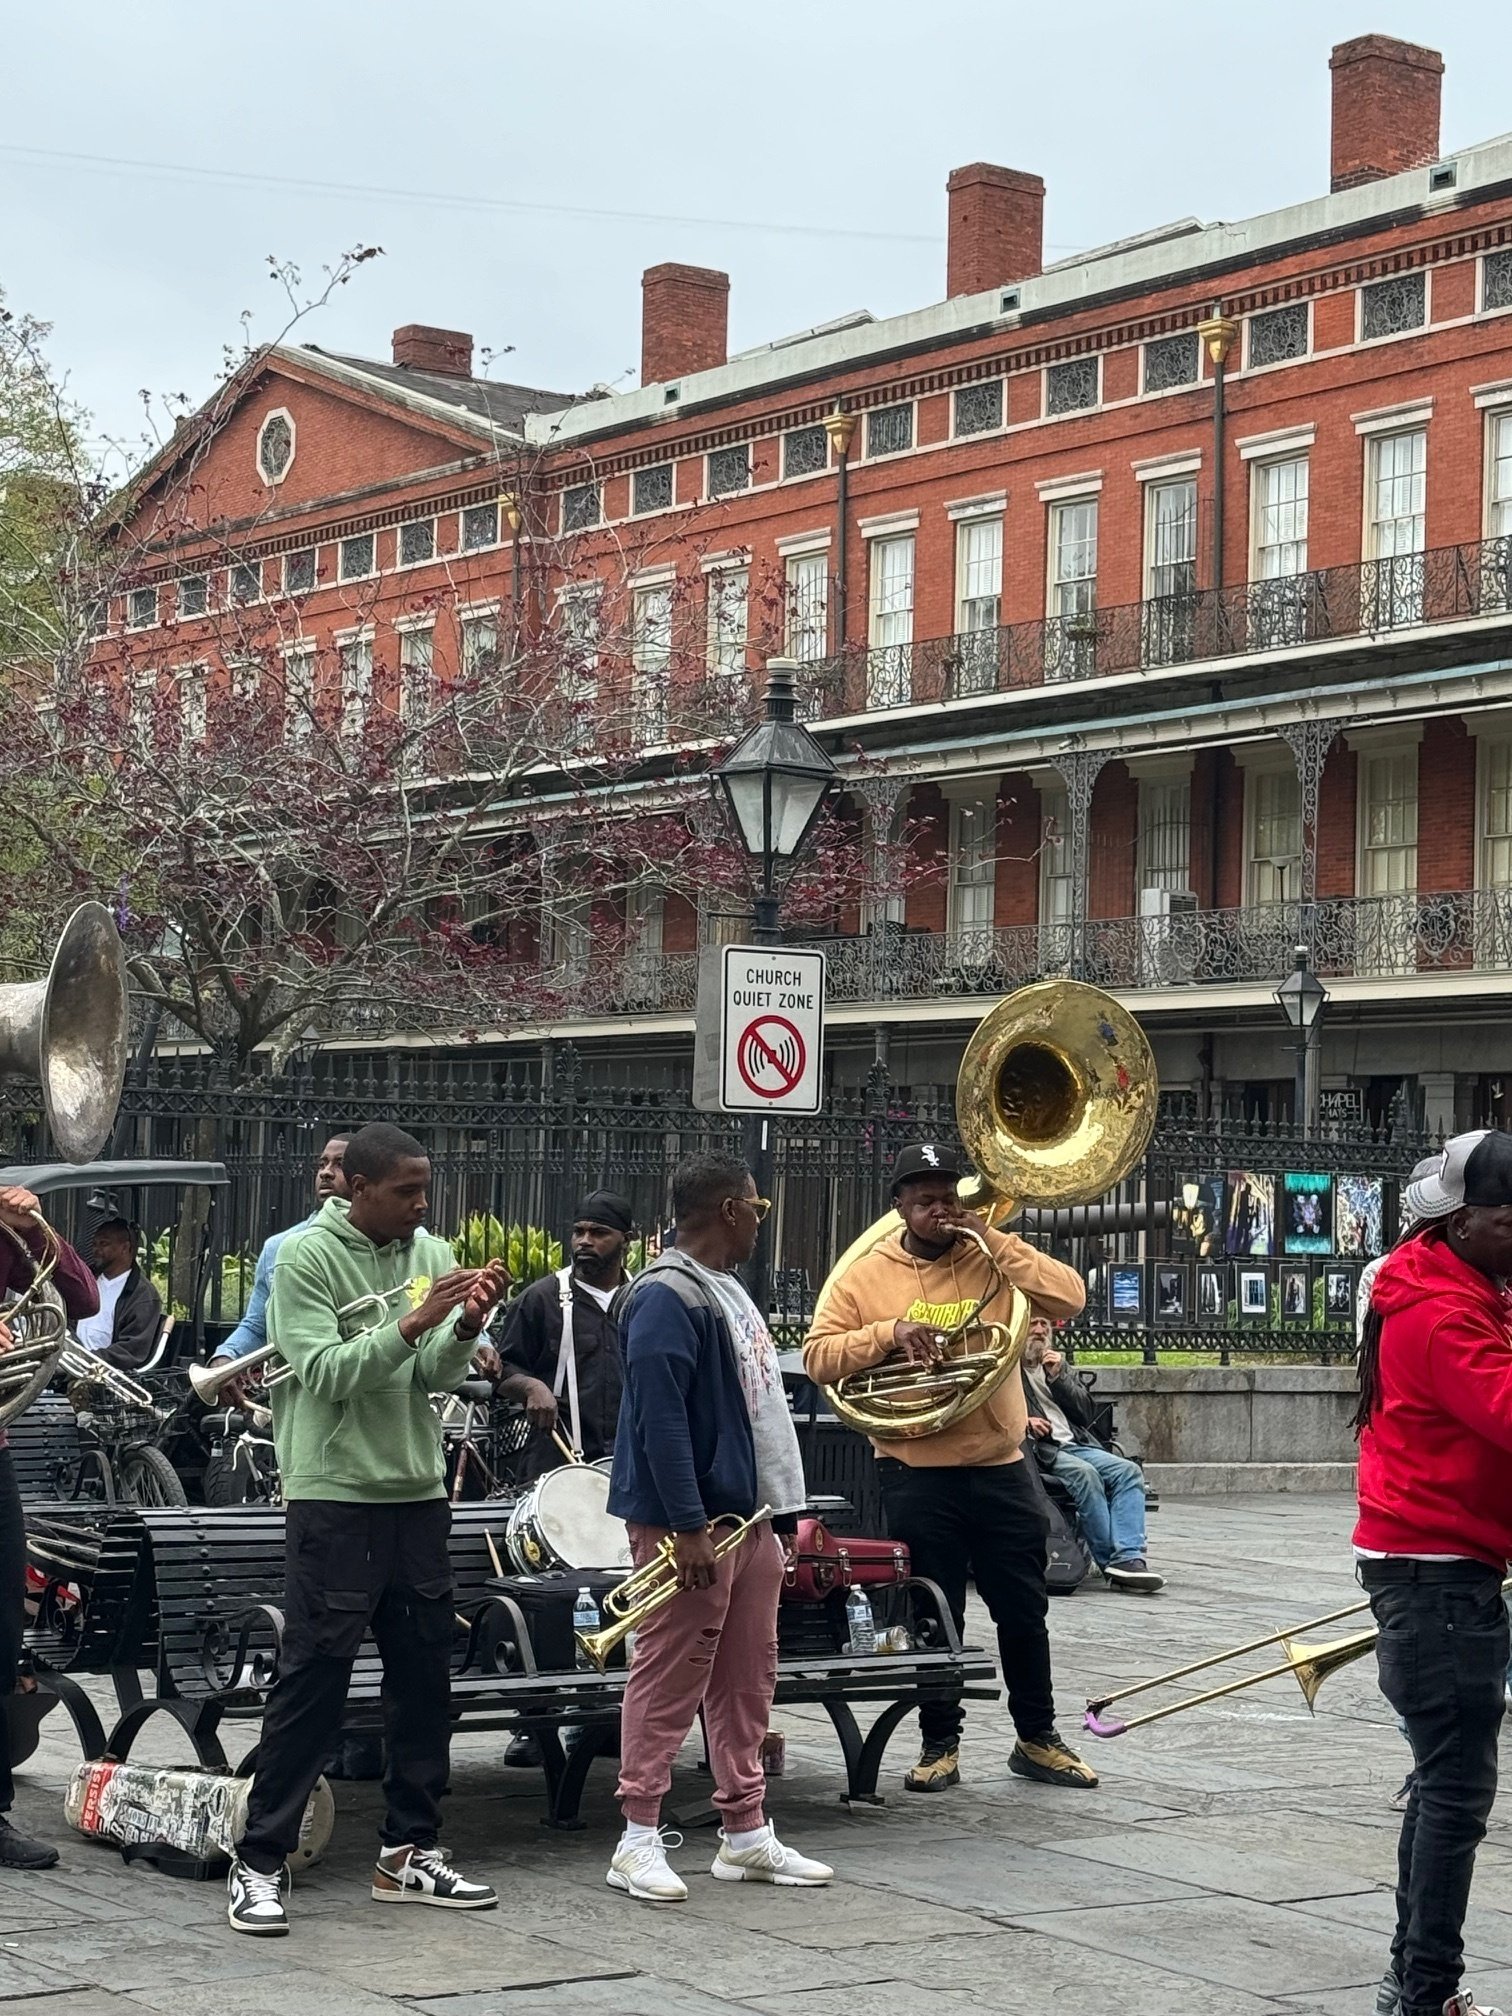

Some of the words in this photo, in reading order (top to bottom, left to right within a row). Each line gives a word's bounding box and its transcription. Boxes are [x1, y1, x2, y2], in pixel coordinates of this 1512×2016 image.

[746, 968, 801, 987] CHURCH
[733, 990, 772, 1007] QUIET
[778, 993, 814, 1009] ZONE
